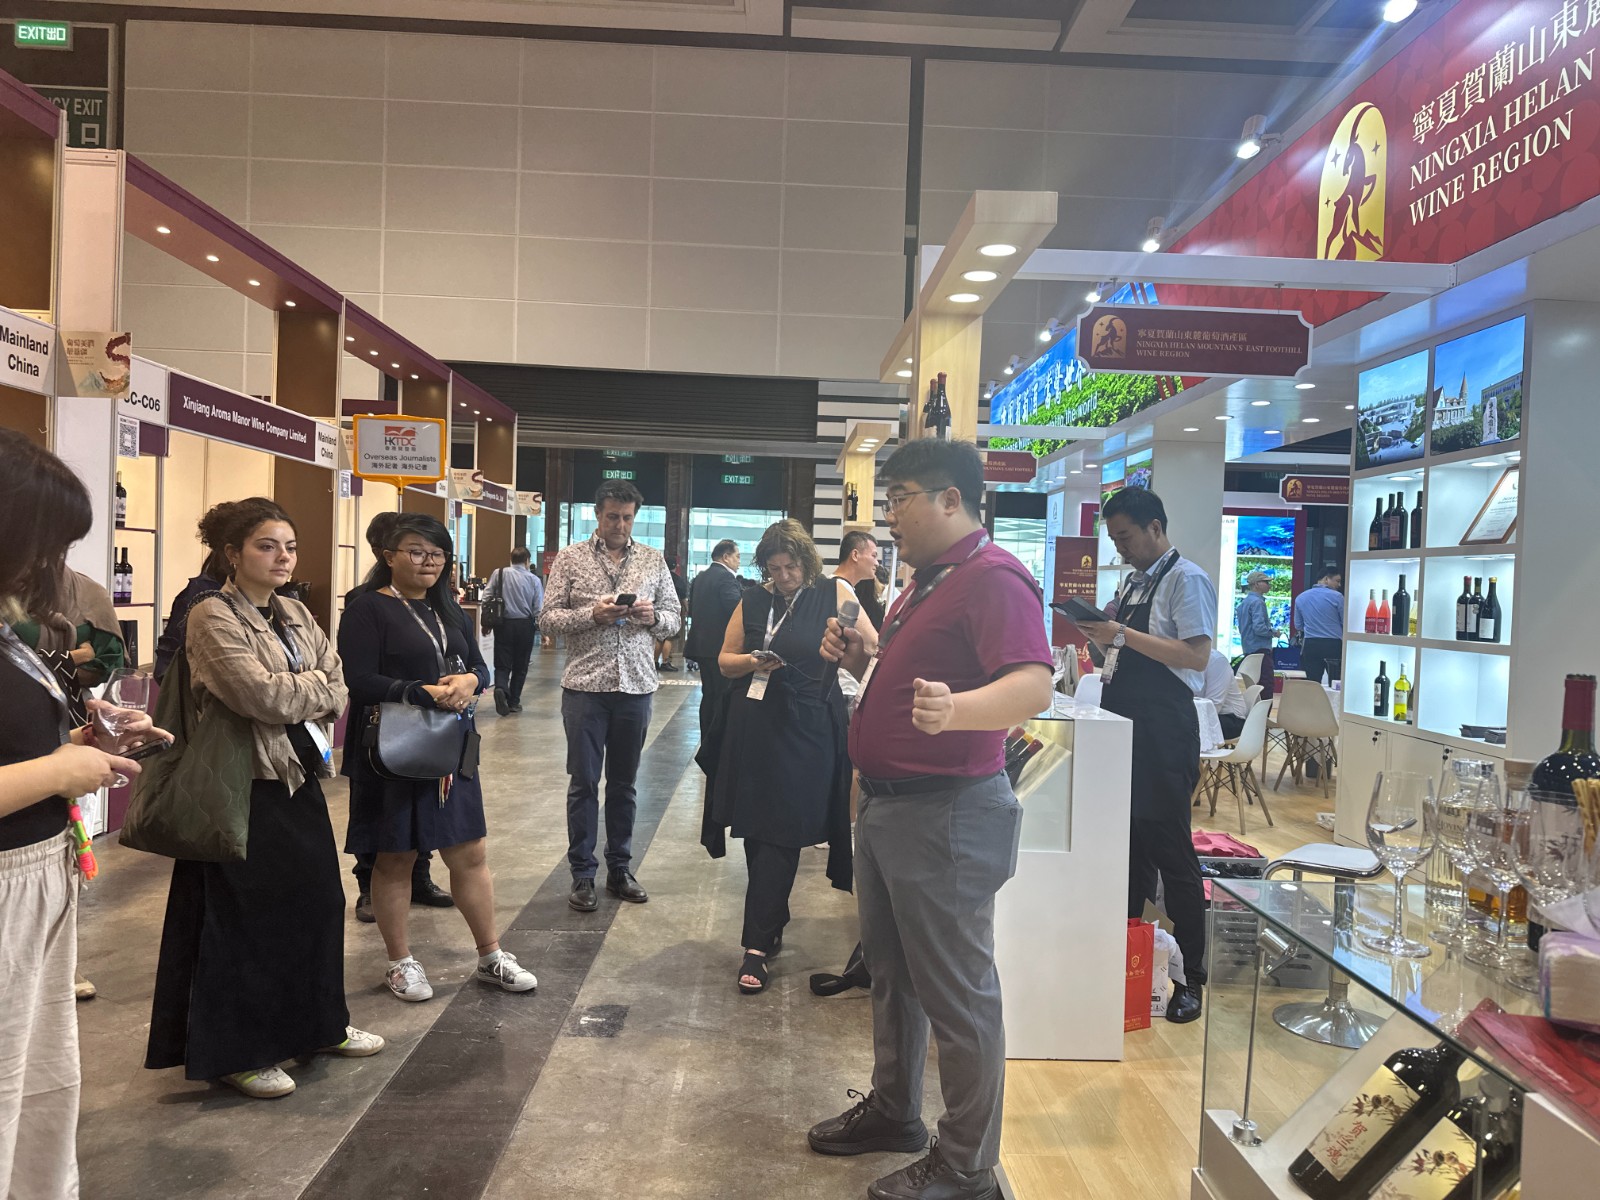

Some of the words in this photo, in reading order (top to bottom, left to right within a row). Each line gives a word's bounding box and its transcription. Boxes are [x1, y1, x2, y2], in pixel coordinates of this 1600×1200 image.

[18, 26, 47, 40] EXIT
[46, 27, 66, 41] 出口
[74, 98, 103, 116] EXIT
[1409, 115, 1498, 191] NINGXIA
[1502, 48, 1596, 134] HELAN
[1409, 173, 1465, 227] WINE
[1471, 109, 1574, 194] REGION
[0, 325, 49, 356] Mainland
[1136, 340, 1169, 349] NINGXIA
[1170, 342, 1195, 350] HELAN
[1265, 346, 1303, 354] FOOTHILL
[1136, 349, 1156, 357] WINE
[1159, 350, 1190, 358] REGION
[8, 354, 40, 378] China
[183, 395, 210, 418] Xinjiang
[211, 405, 232, 422] Aroma
[232, 410, 251, 427] Manor
[251, 416, 265, 431] Wine
[265, 421, 289, 441] Company
[289, 428, 307, 444] Limited
[318, 431, 337, 446] Mainland
[384, 436, 416, 446] HKTDC
[321, 447, 334, 460] China
[363, 453, 398, 461] Overseas
[399, 455, 437, 463] Journalists
[371, 462, 398, 470] 海外記者
[724, 475, 739, 484] EXIT
